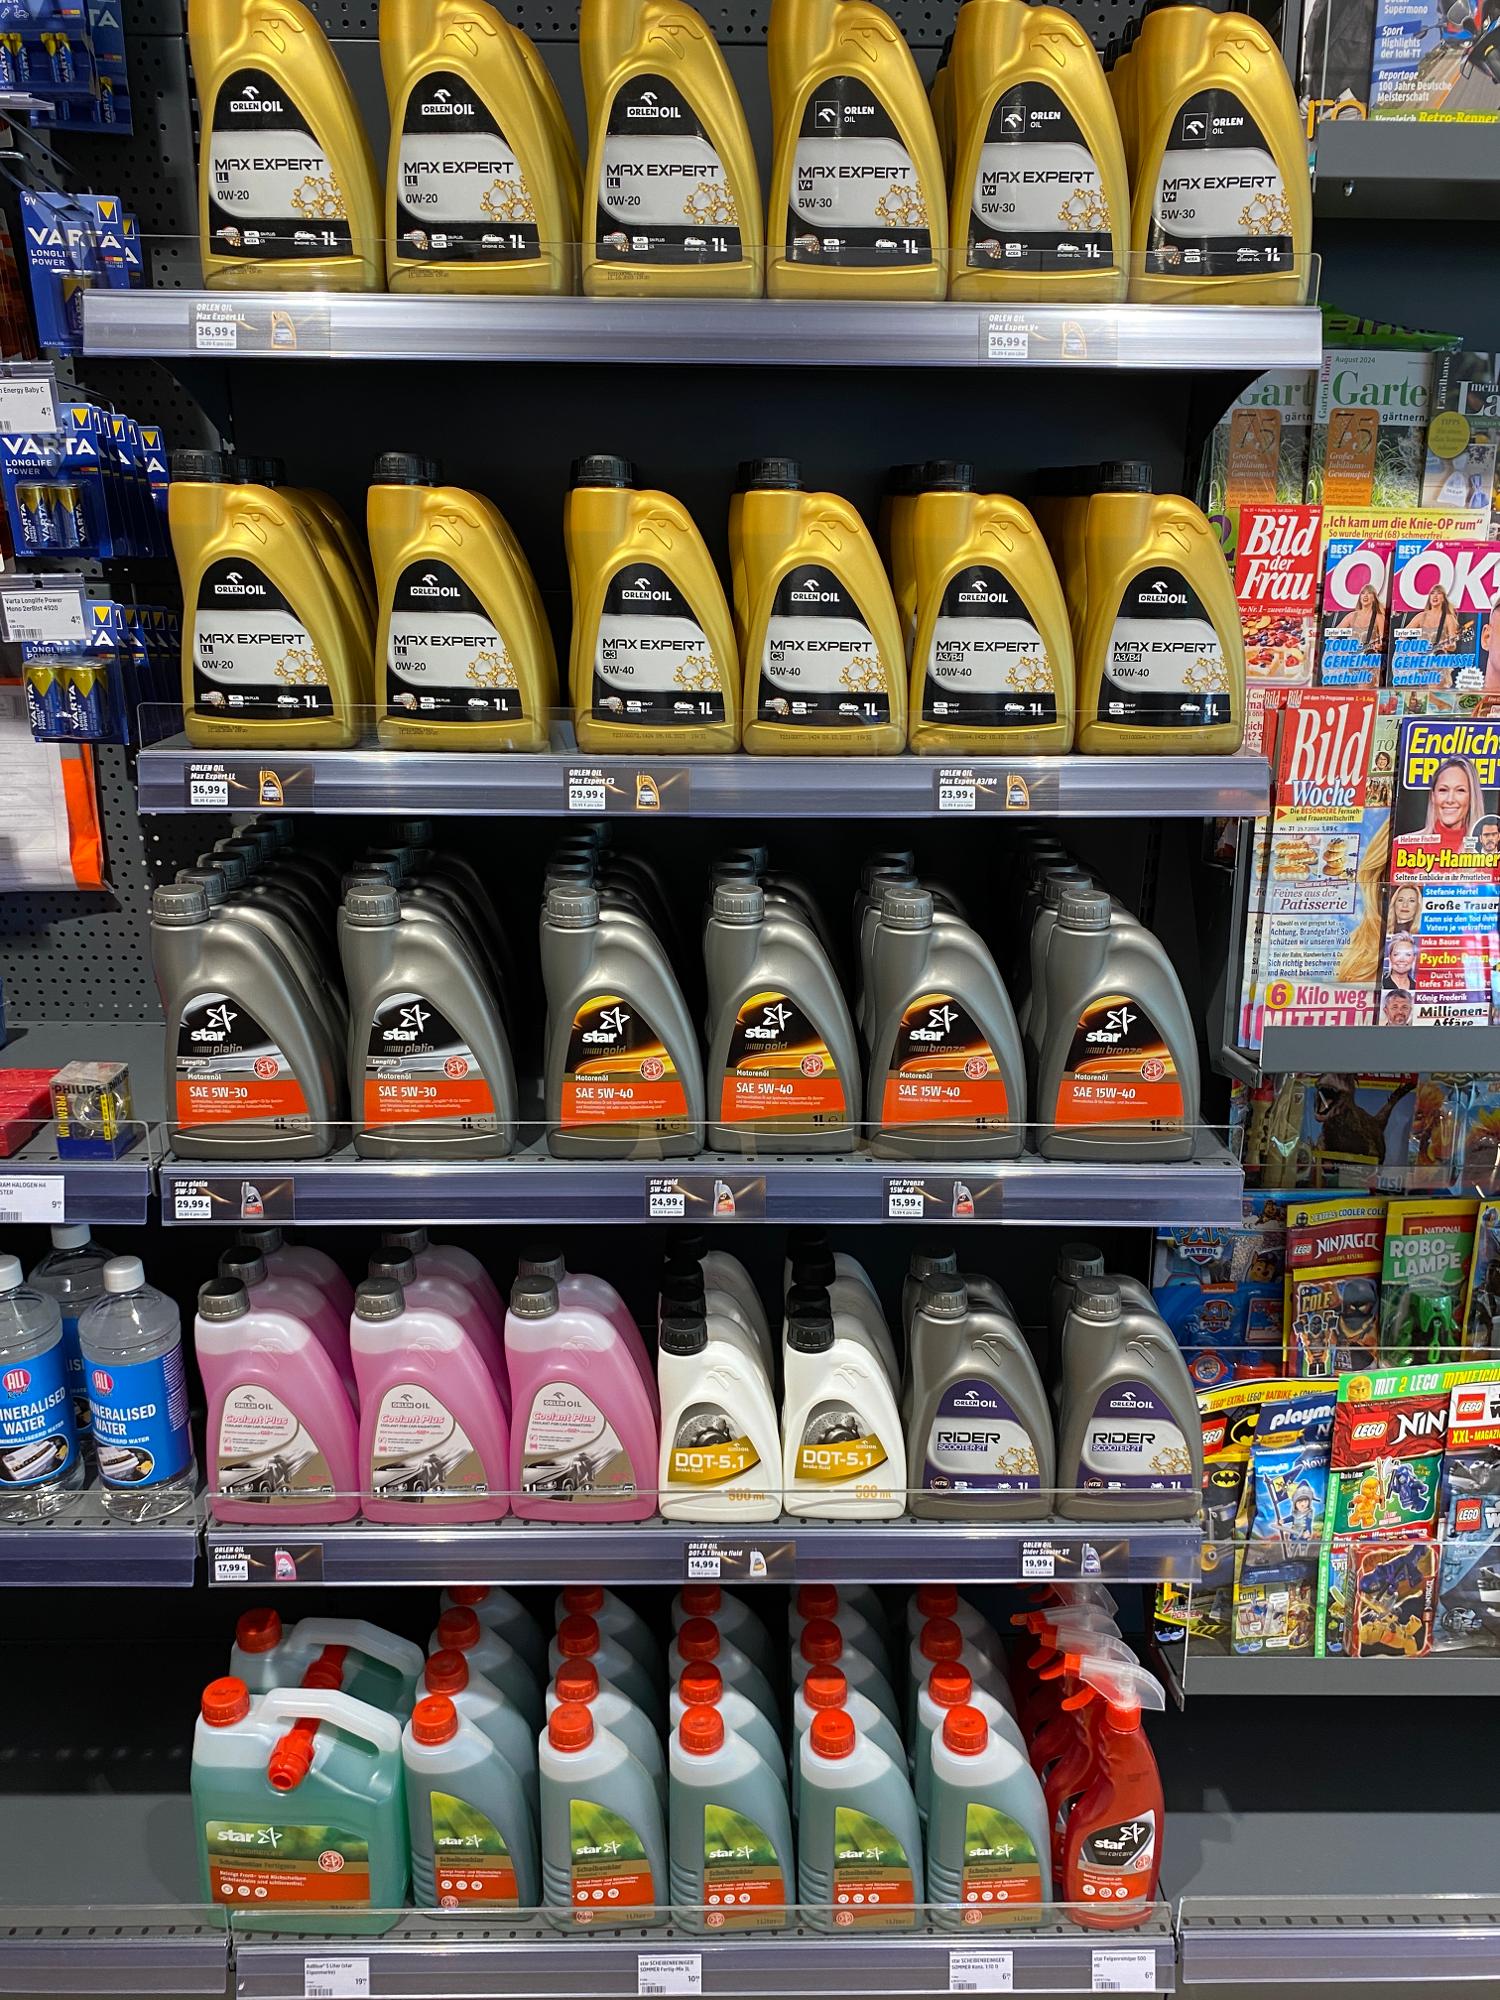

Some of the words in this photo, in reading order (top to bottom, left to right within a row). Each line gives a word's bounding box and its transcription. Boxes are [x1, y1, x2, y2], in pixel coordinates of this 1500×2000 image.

[1384, 4, 1428, 15] Supermono
[1382, 26, 1404, 36] Sport
[1381, 38, 1420, 49] Highlights
[1378, 70, 1419, 81] Reportage
[1378, 93, 1429, 102] Meisterschaft
[231, 101, 261, 112] ORLEN
[262, 101, 283, 112] OIL
[627, 107, 658, 118] ORLEN
[660, 106, 681, 118] OIL
[1030, 111, 1061, 121] ORLEN
[1212, 117, 1244, 127] ORLEN
[215, 158, 251, 171] MAX
[253, 158, 324, 171] EXPERT
[404, 162, 441, 174] MAX
[443, 162, 514, 174] EXPERT
[607, 164, 645, 177] MAX
[647, 164, 719, 177] EXPERT
[799, 166, 837, 179] MAX
[839, 166, 911, 179] EXPERT
[982, 172, 1021, 184] MAX
[1022, 172, 1095, 184] EXPERT
[1162, 178, 1201, 191] MAX
[1204, 176, 1277, 190] EXPERT
[217, 190, 250, 200] 0W-20
[406, 193, 438, 203] 0W-20
[607, 196, 641, 206] 0W-20
[798, 198, 832, 208] 5W-30
[981, 202, 1016, 213] 5W-30
[1161, 209, 1196, 220] 5W-30
[28, 227, 122, 250] VARTA
[31, 249, 78, 259] LONGLIFE
[32, 258, 66, 267] POWER
[198, 326, 228, 337] 36,99
[990, 336, 1020, 347] 36,99
[1336, 356, 1359, 365] August
[1360, 356, 1376, 364] 2024
[1436, 356, 1450, 410] Landhaus
[3, 387, 24, 395] Energy
[24, 386, 40, 395] Baby
[2, 438, 96, 455] VARTA
[1328, 470, 1371, 480] Gewinnspiel
[1241, 515, 1320, 557] Bild
[1331, 544, 1354, 554] BEST
[1399, 544, 1421, 555] BEST
[1270, 555, 1295, 571] der
[1238, 559, 1314, 601] Frau
[214, 584, 245, 595] ORLEN
[246, 585, 266, 595] OIL
[622, 590, 652, 600] ORLEN
[652, 590, 672, 601] OIL
[200, 634, 235, 645] MAX
[237, 634, 306, 645] EXPERT
[394, 635, 428, 647] MAX
[430, 635, 498, 647] EXPERT
[602, 639, 638, 651] MAX
[640, 639, 705, 651] EXPERT
[770, 640, 805, 652] MAX
[807, 640, 872, 652] EXPERT
[936, 641, 972, 653] MAX
[974, 641, 1040, 653] EXPERT
[1114, 642, 1150, 653] MAX
[1152, 642, 1217, 653] EXPERT
[1394, 640, 1433, 653] TOUR-
[936, 653, 964, 662] A3/B4
[1114, 653, 1142, 662] A3/B4
[1324, 654, 1381, 668] GEHEIMN
[1394, 654, 1476, 668] GEHEIMNISSE
[202, 660, 234, 670] 0W-20
[395, 662, 426, 671] 0W-20
[603, 666, 635, 675] 5W-40
[770, 667, 801, 676] 5W-40
[936, 668, 972, 677] 10W-40
[1112, 668, 1150, 677] 10W-40
[1322, 672, 1372, 685] enthüllt
[1394, 671, 1442, 685] enthüllt
[1286, 704, 1373, 787] Bild
[192, 786, 220, 795] 36,99
[571, 790, 598, 800] 29,99
[941, 790, 968, 800] 23,99
[1293, 778, 1356, 806] Woche
[1396, 848, 1500, 873] Baby-Hammer
[1425, 888, 1457, 896] Stefanie
[1280, 898, 1348, 911] Patisserie
[1426, 901, 1461, 911] Große
[1464, 901, 1499, 910] Trauer
[1270, 984, 1287, 1005] 6
[1297, 986, 1330, 1005] Kilo
[1334, 988, 1368, 1009] weg
[1416, 994, 1438, 1002] König
[1420, 1006, 1488, 1019] Millionen-
[191, 1029, 225, 1042] star
[383, 1028, 417, 1042] star
[582, 1030, 617, 1044] star
[744, 1026, 779, 1040] star
[910, 1028, 944, 1042] star
[1086, 1030, 1122, 1044] star
[54, 1084, 102, 1095] PHILIPS
[189, 1086, 209, 1098] SAE
[211, 1086, 248, 1098] 5W-30
[378, 1086, 398, 1097] SAE
[400, 1086, 437, 1097] 5W-30
[575, 1088, 595, 1099] SAE
[598, 1088, 634, 1099] 5W-40
[736, 1083, 755, 1094] SAE
[758, 1083, 793, 1094] 5W-40
[899, 1086, 918, 1097] SAE
[920, 1086, 961, 1097] 15W-40
[1073, 1087, 1092, 1098] SAE
[1095, 1087, 1136, 1098] 15W-40
[177, 1200, 204, 1209] 29,99
[652, 1198, 677, 1207] 24,99
[891, 1198, 916, 1207] 15,99
[1339, 1208, 1365, 1216] COOLER
[1315, 1233, 1380, 1259] NINJAGO
[1390, 1238, 1455, 1257] ROBO-
[1184, 1248, 1218, 1256] PATROL
[1394, 1253, 1461, 1277] LAMPE
[1302, 1292, 1332, 1312] COLE
[1374, 1378, 1397, 1396] MIT
[1399, 1376, 1408, 1393] 2
[1410, 1373, 1439, 1392] LEGO
[954, 1400, 979, 1408] ORLEN
[980, 1400, 998, 1408] OIL
[1457, 1401, 1483, 1414] LEGO
[224, 1414, 264, 1424] Coolant
[265, 1416, 289, 1426] Plus
[532, 1412, 572, 1422] Coolant
[572, 1414, 596, 1423] Plus
[4, 1415, 46, 1436] WATER
[1353, 1423, 1386, 1439] LEGO
[938, 1432, 1001, 1444] RIDER
[1092, 1432, 1156, 1444] RIDER
[676, 1452, 745, 1469] DOT-5.1
[802, 1450, 873, 1467] DOT-5.1
[218, 1564, 242, 1573] 17,99
[690, 1560, 714, 1569] 14,99
[1025, 1560, 1048, 1568] 19,99
[218, 1830, 255, 1843] star
[576, 1845, 602, 1855] star
[1094, 1838, 1126, 1851] star
[969, 1847, 995, 1857] star
